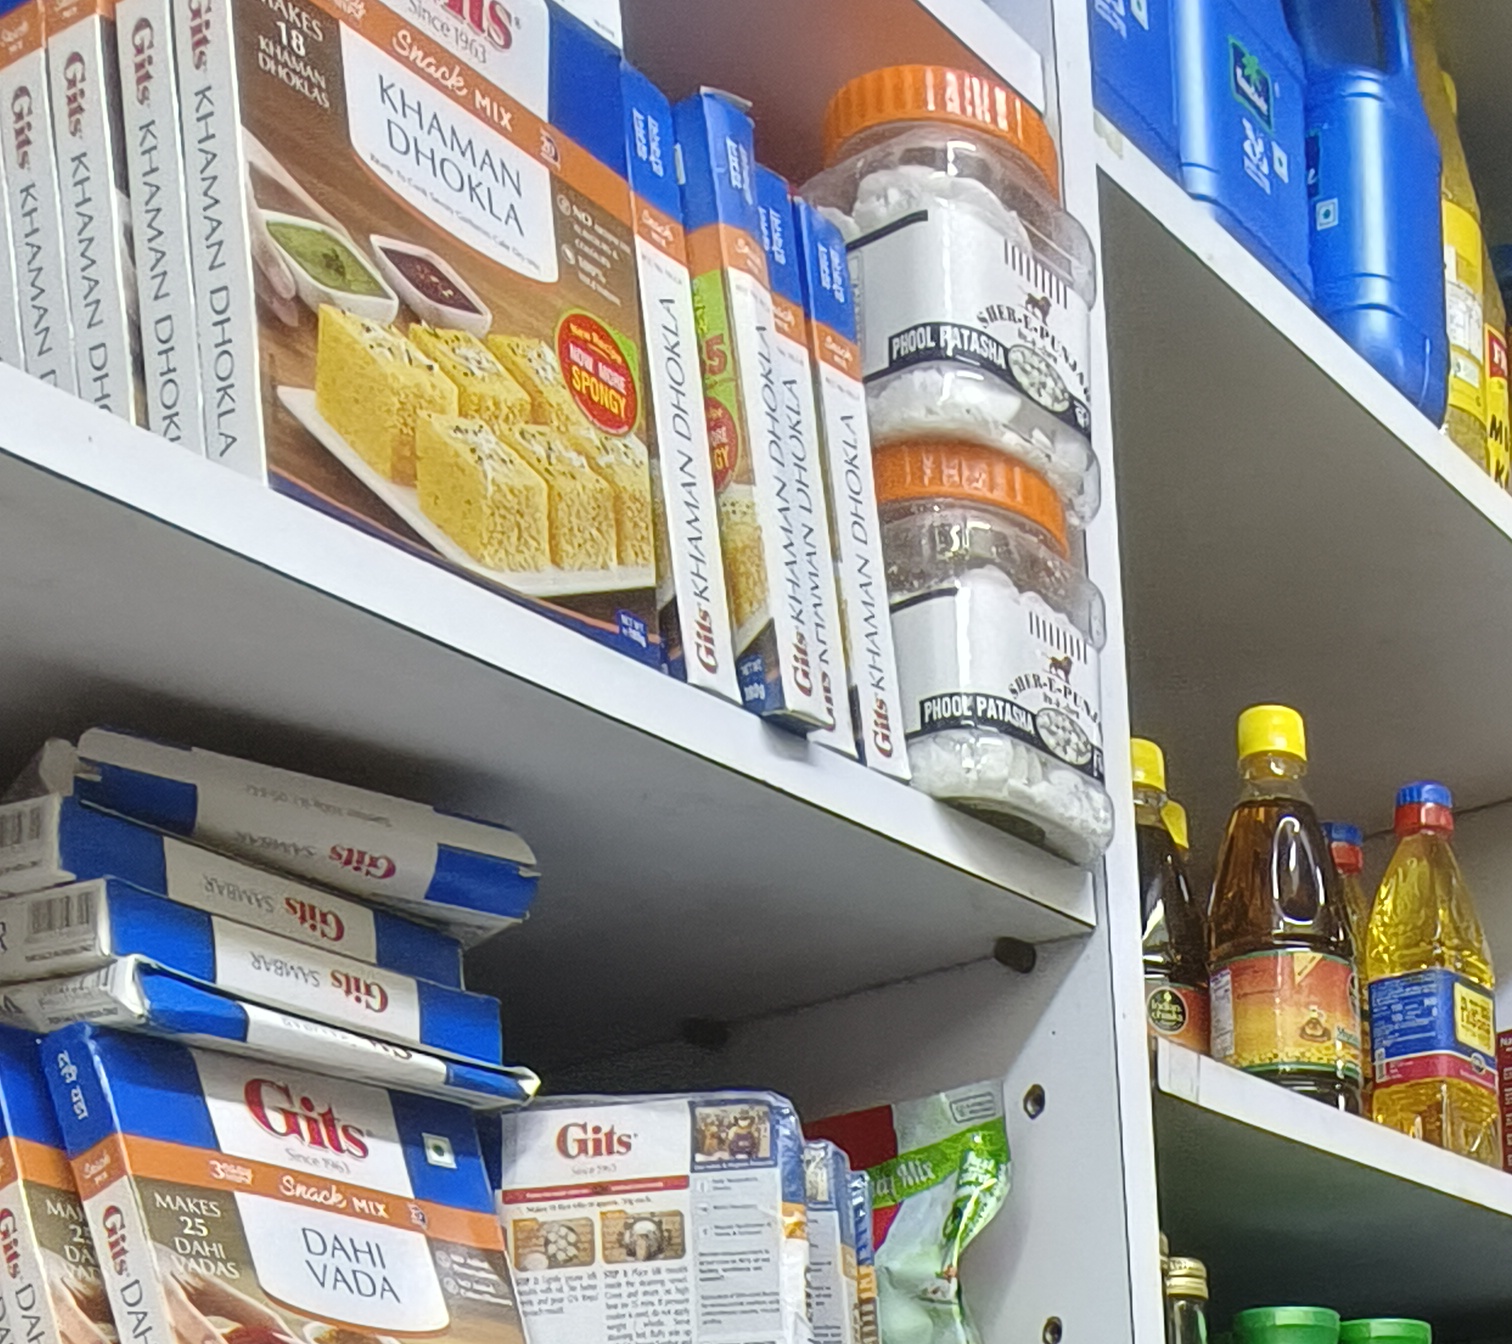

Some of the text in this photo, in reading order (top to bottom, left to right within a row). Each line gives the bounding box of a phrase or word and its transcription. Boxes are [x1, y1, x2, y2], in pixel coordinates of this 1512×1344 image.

[259, 35, 326, 88] KHAMAN
[277, 22, 305, 56] 18
[258, 53, 330, 109] DHOKLAS
[393, 29, 513, 131] Snack MIX
[131, 17, 171, 301] Gits KHAMAN
[378, 74, 522, 198] KHAMAN
[63, 51, 104, 329] Gits KHAMAN
[387, 118, 525, 237] DHOKLA
[11, 86, 53, 357] Gits KHAMAN
[194, 86, 238, 457] KHAMAN DHOKLA
[892, 326, 1007, 370] PHOOL PATASHA
[571, 364, 627, 420] SPONGY
[661, 297, 718, 674] Gits KHAMAN DHOKLA
[754, 325, 814, 697] Gits KHAMAN DHOKLA
[840, 414, 894, 758] Gits KHAMAN DHOKLA
[924, 698, 1035, 737] PHOOL PATASHA
[329, 844, 396, 881] Gits
[204, 874, 345, 942] Gits SAMBAR
[248, 951, 389, 1013] Gits SAMBAR
[244, 1076, 370, 1159] Gits
[556, 1121, 633, 1160] Gits
[154, 1192, 221, 1219] MAKES
[279, 1176, 390, 1220] Snack MIX
[101, 1205, 129, 1278] Gits
[174, 1237, 226, 1259] DAHI
[180, 1215, 209, 1238] 25
[301, 1226, 387, 1269] DAHI
[170, 1254, 240, 1280] VADAS
[305, 1258, 401, 1304] VADA
